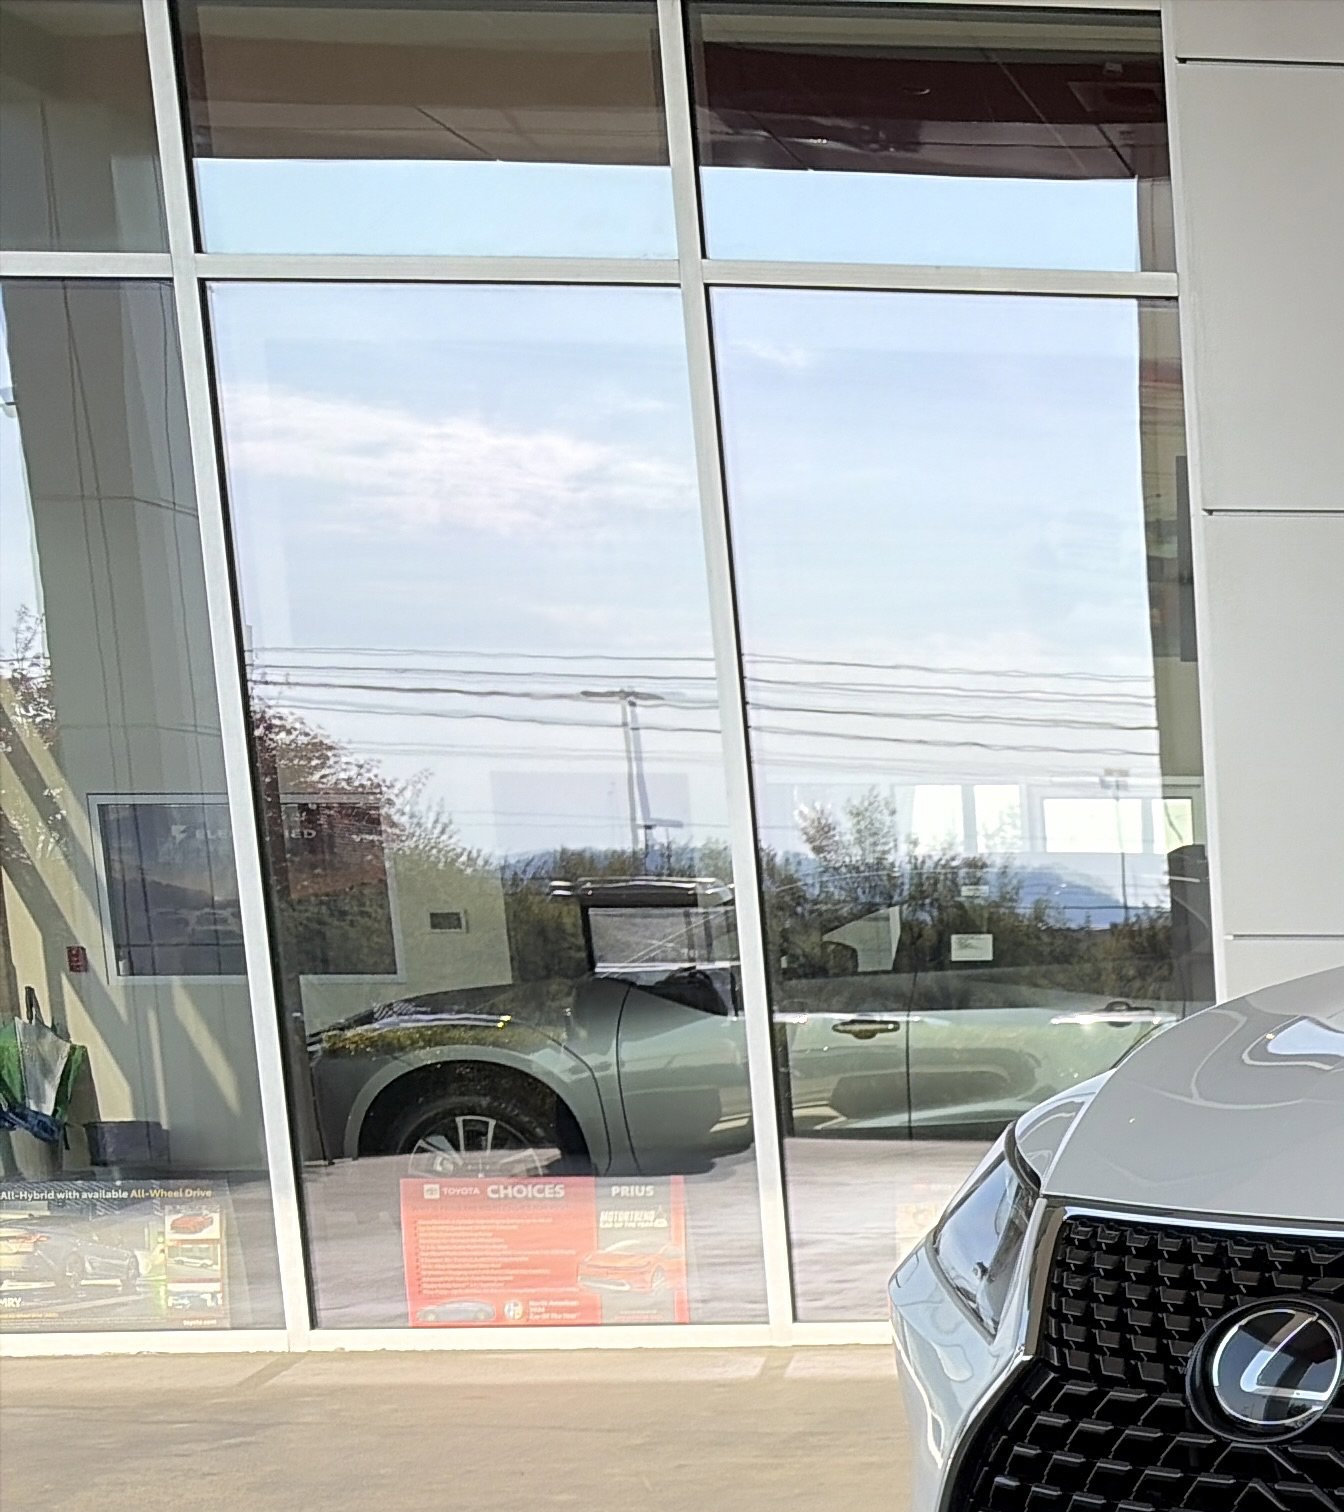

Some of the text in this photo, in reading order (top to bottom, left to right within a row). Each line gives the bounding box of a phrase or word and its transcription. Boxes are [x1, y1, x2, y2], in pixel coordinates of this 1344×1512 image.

[0, 1187, 212, 1201] All-Hybrid with available All-Wheel Drive
[442, 1184, 565, 1199] TOYOTA CHOICES
[611, 1185, 654, 1197] PRIUS
